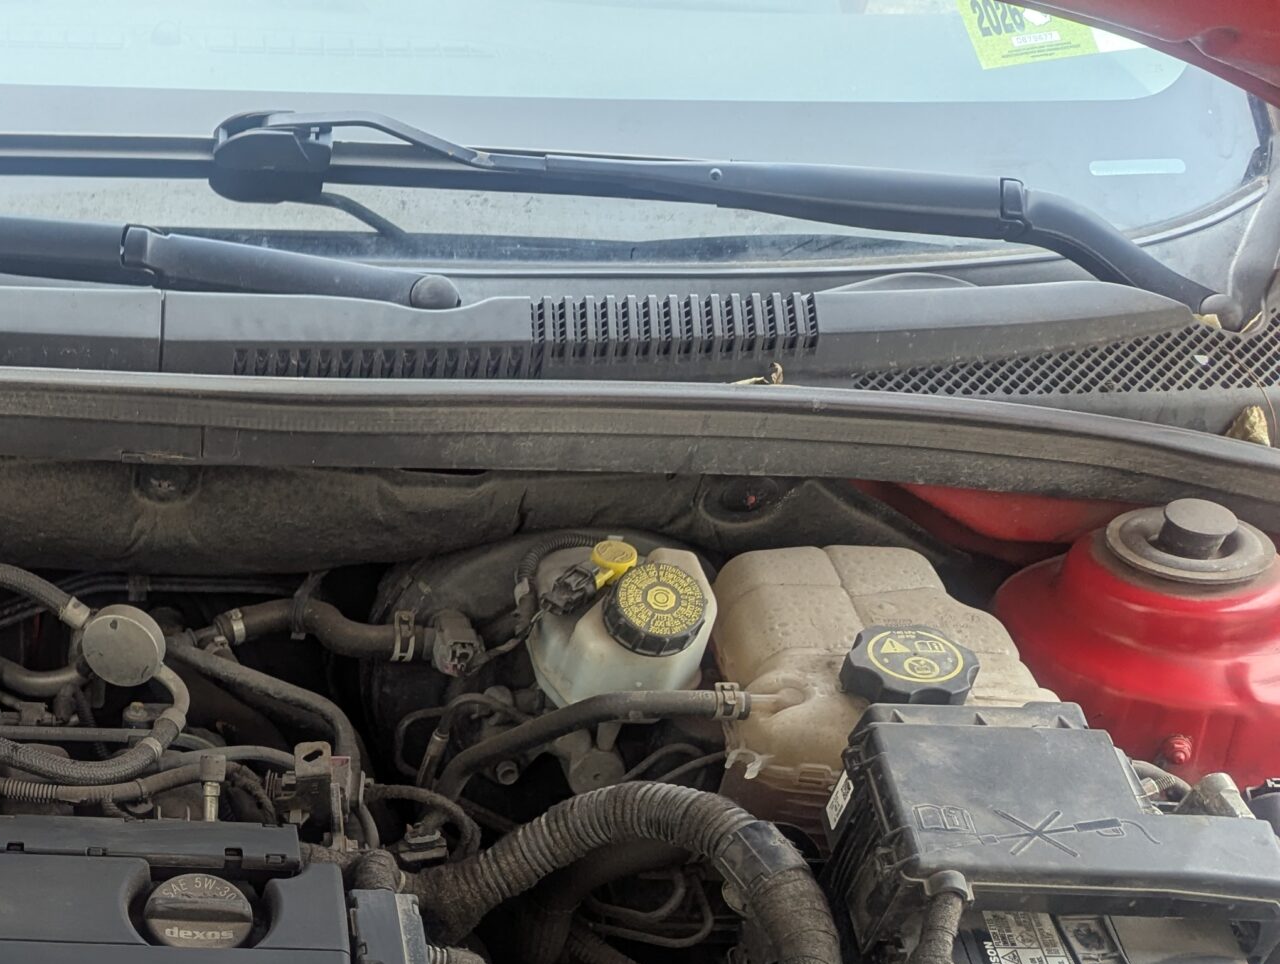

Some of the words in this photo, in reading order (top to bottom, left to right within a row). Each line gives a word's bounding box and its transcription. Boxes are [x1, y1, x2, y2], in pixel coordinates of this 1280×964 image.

[162, 879, 188, 898] SAE
[194, 877, 237, 900] 5W-30
[164, 926, 234, 940] dexos
